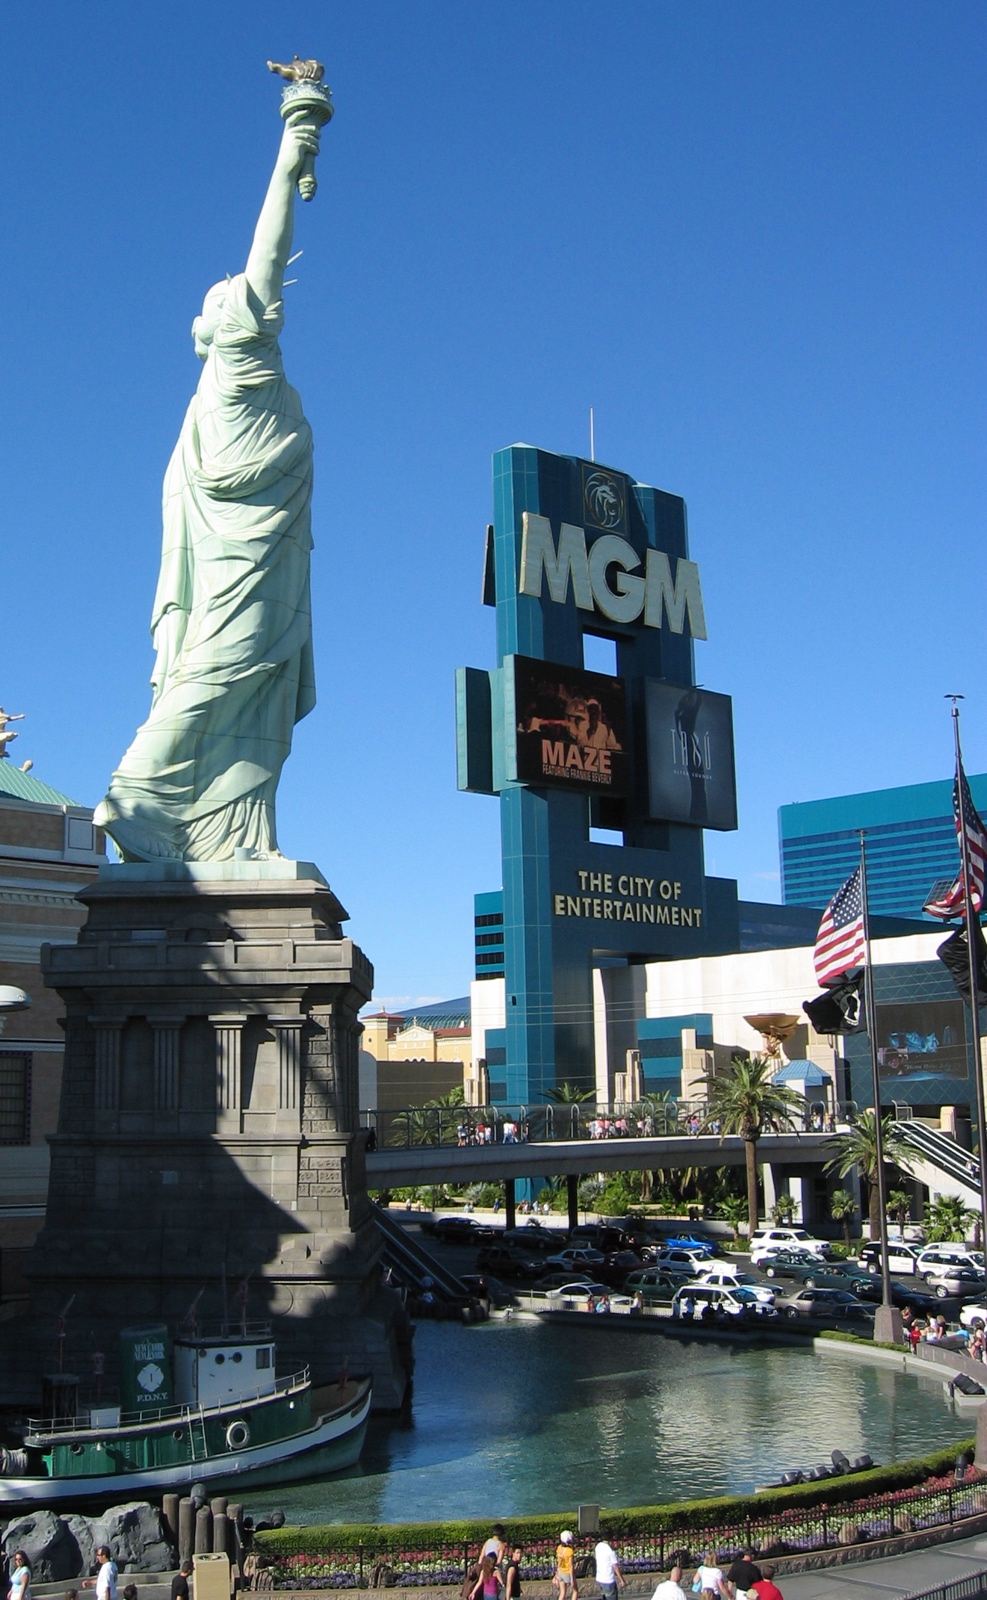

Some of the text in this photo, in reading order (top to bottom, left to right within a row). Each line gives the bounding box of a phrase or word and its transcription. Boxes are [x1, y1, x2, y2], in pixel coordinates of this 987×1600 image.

[519, 511, 707, 639] MGM
[541, 739, 612, 775] MAZE
[578, 870, 682, 900] THE CITY OF
[554, 895, 702, 928] ENTERTAINMENT
